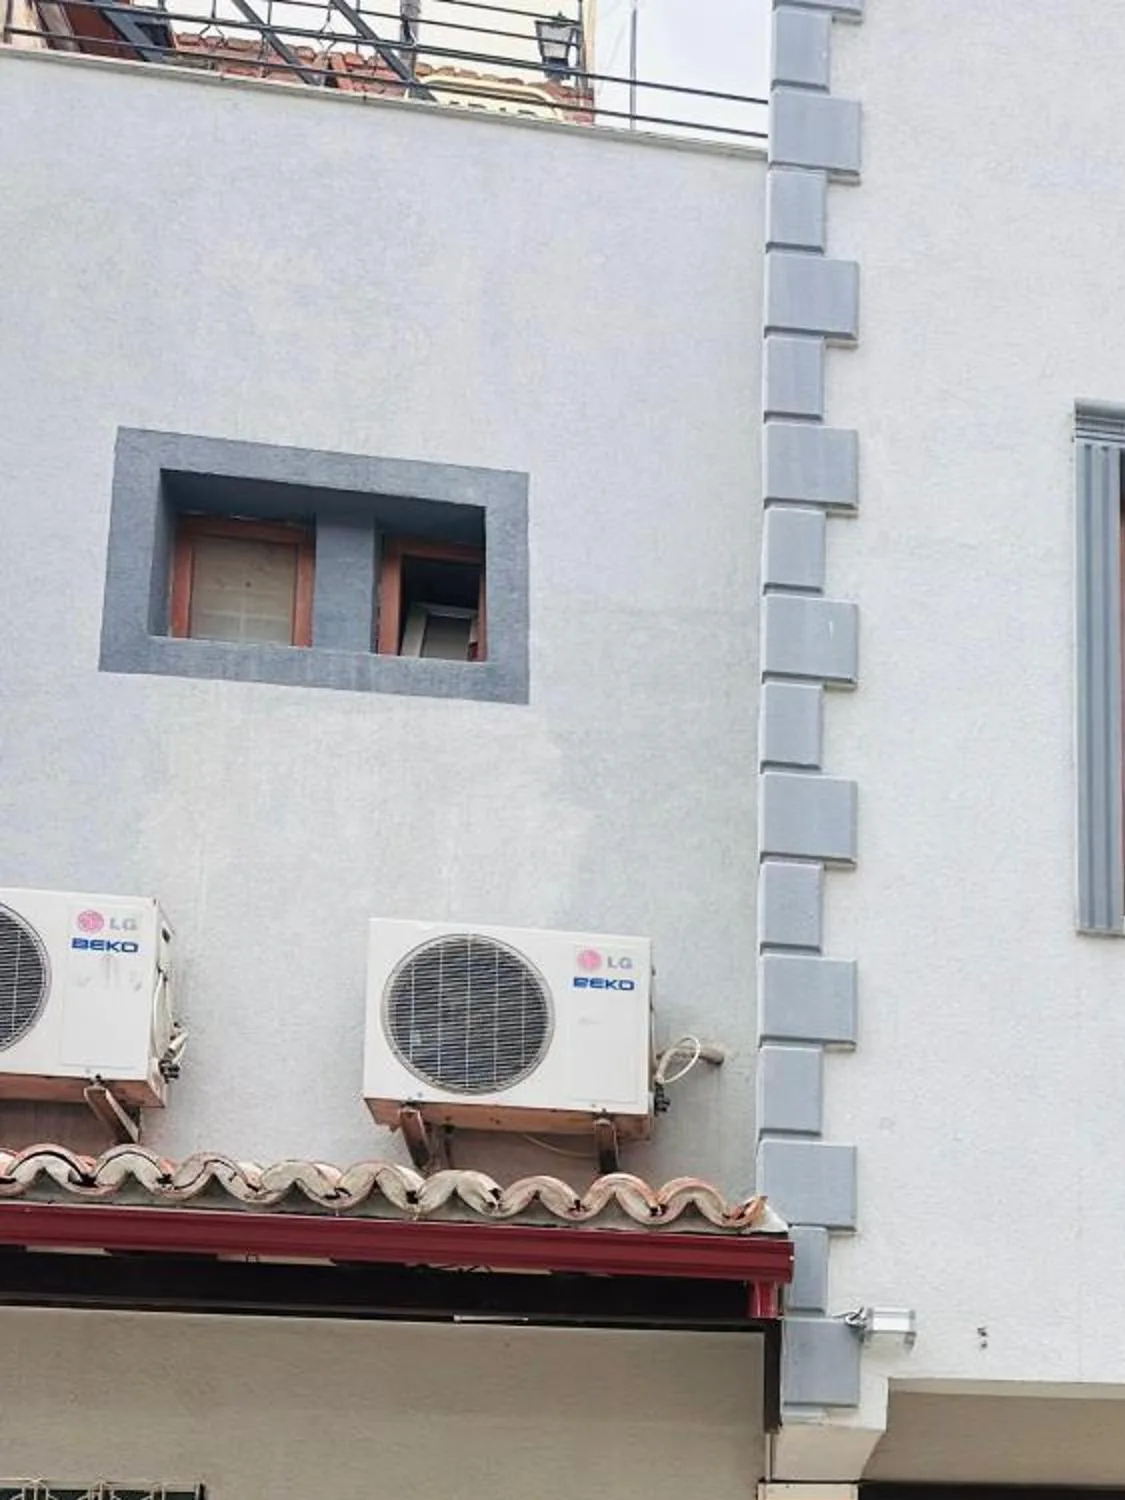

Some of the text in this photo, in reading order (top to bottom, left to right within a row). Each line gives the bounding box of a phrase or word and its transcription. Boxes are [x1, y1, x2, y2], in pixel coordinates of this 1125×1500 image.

[109, 917, 138, 931] LG
[71, 937, 139, 953] BEKO
[607, 955, 633, 969] LG
[573, 977, 635, 991] BEKO
